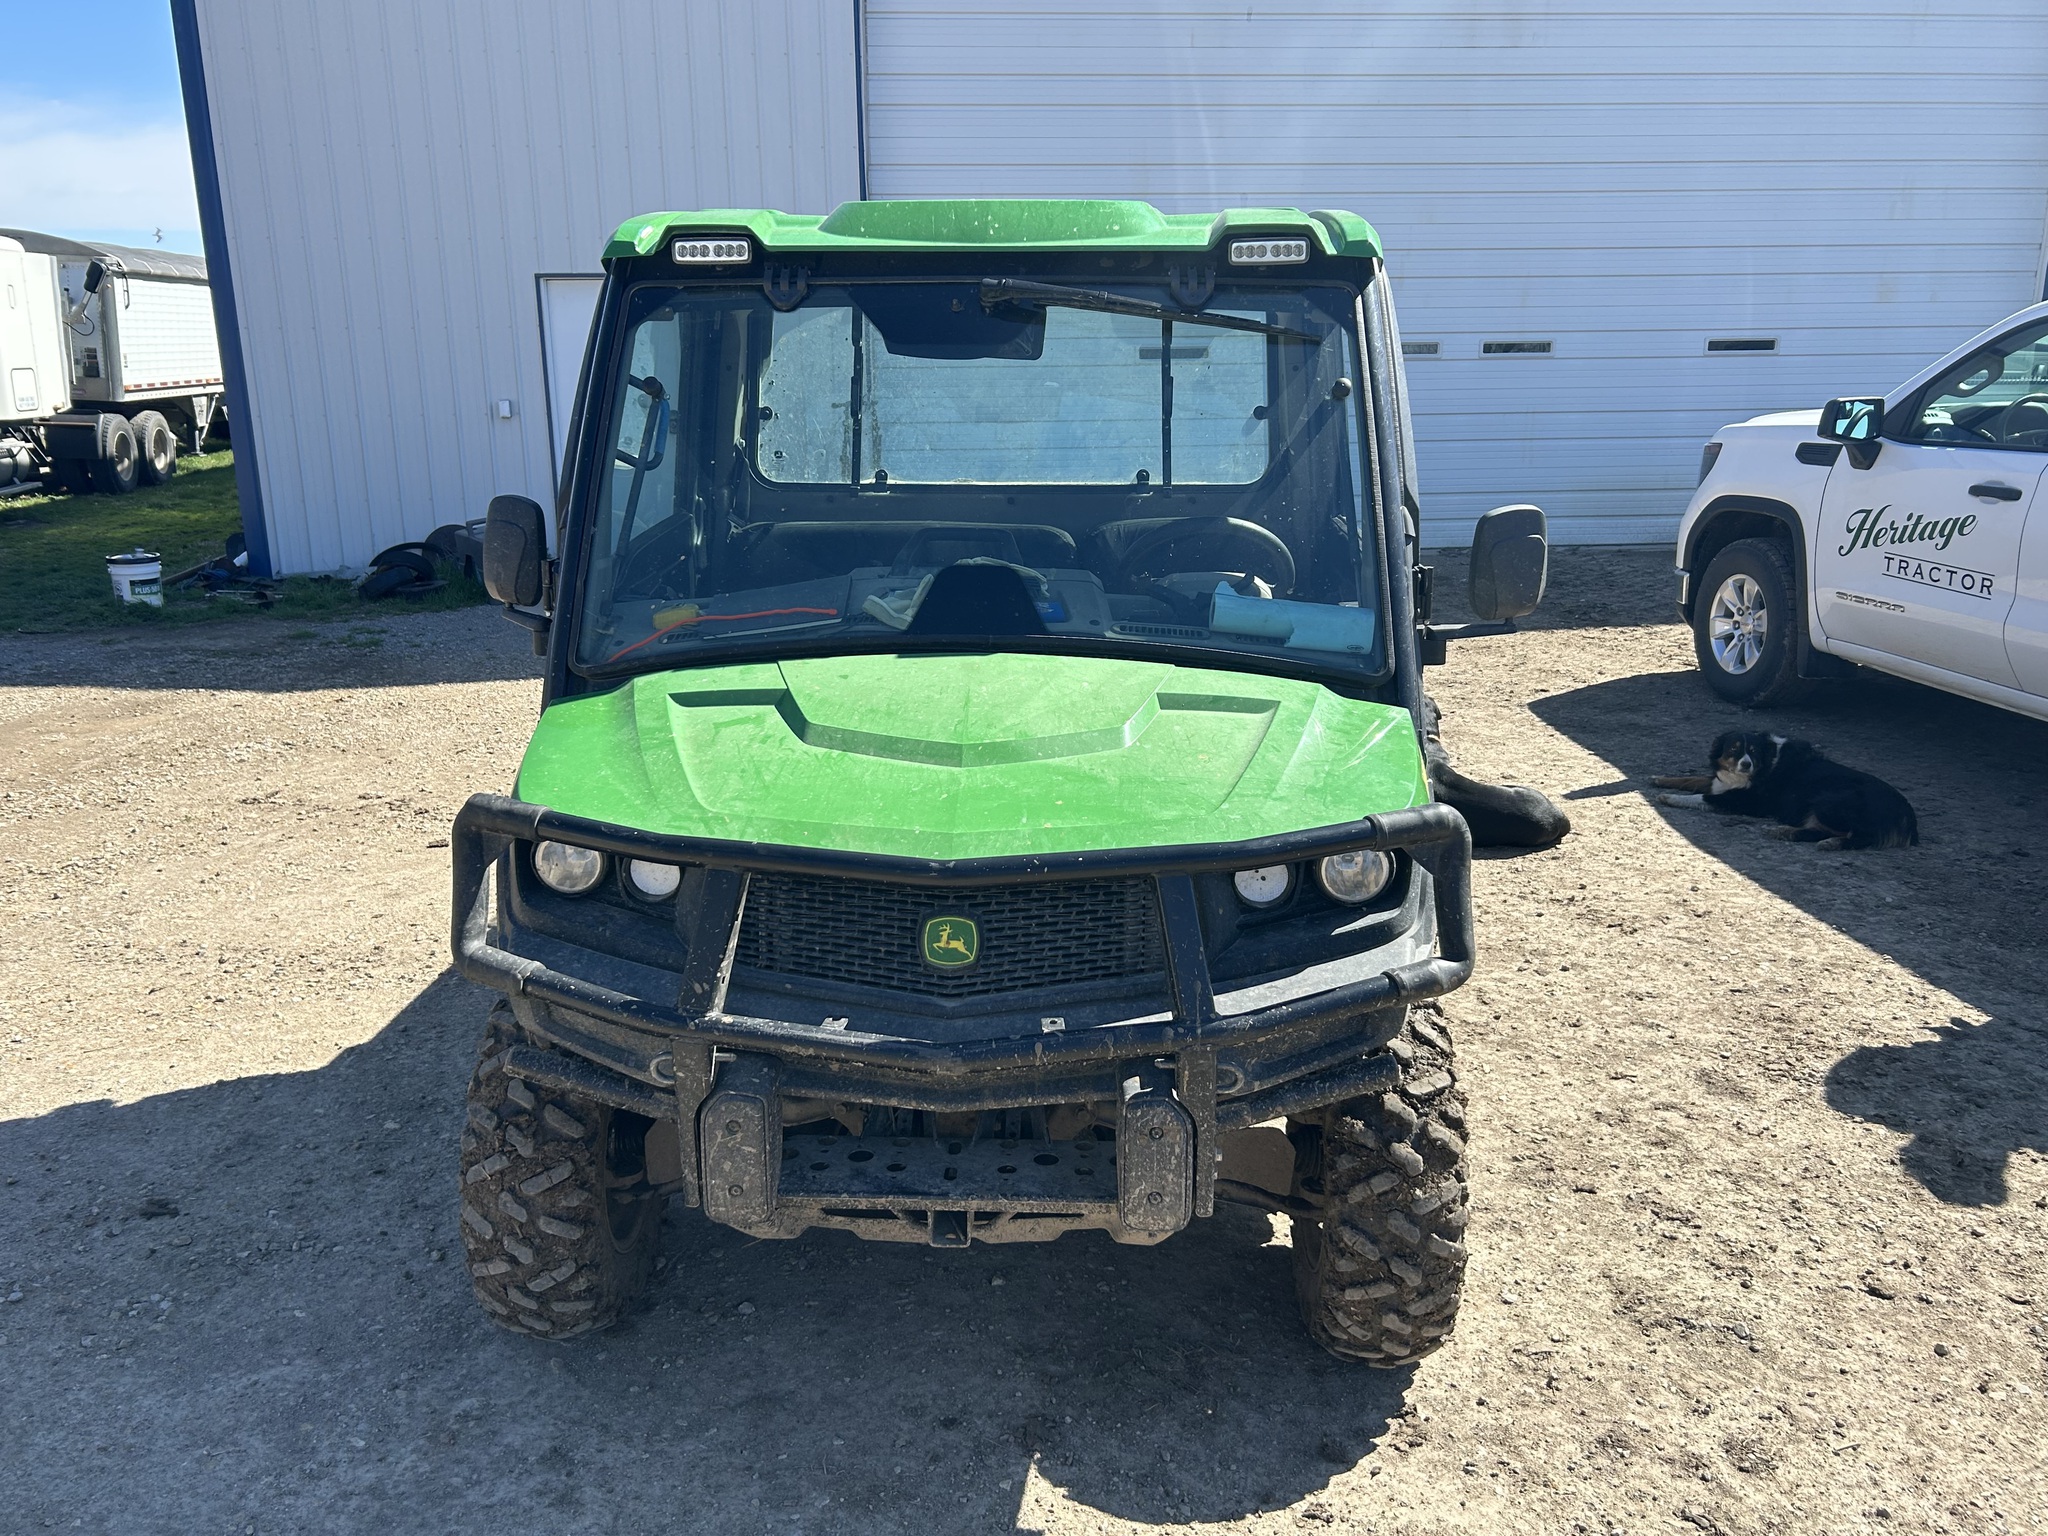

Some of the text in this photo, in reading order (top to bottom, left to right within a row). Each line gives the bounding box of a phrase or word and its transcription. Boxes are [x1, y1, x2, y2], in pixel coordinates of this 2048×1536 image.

[1838, 504, 1979, 557] Heritage
[1883, 556, 1994, 596] TRACTOR
[1835, 591, 1906, 613] SIERRA
